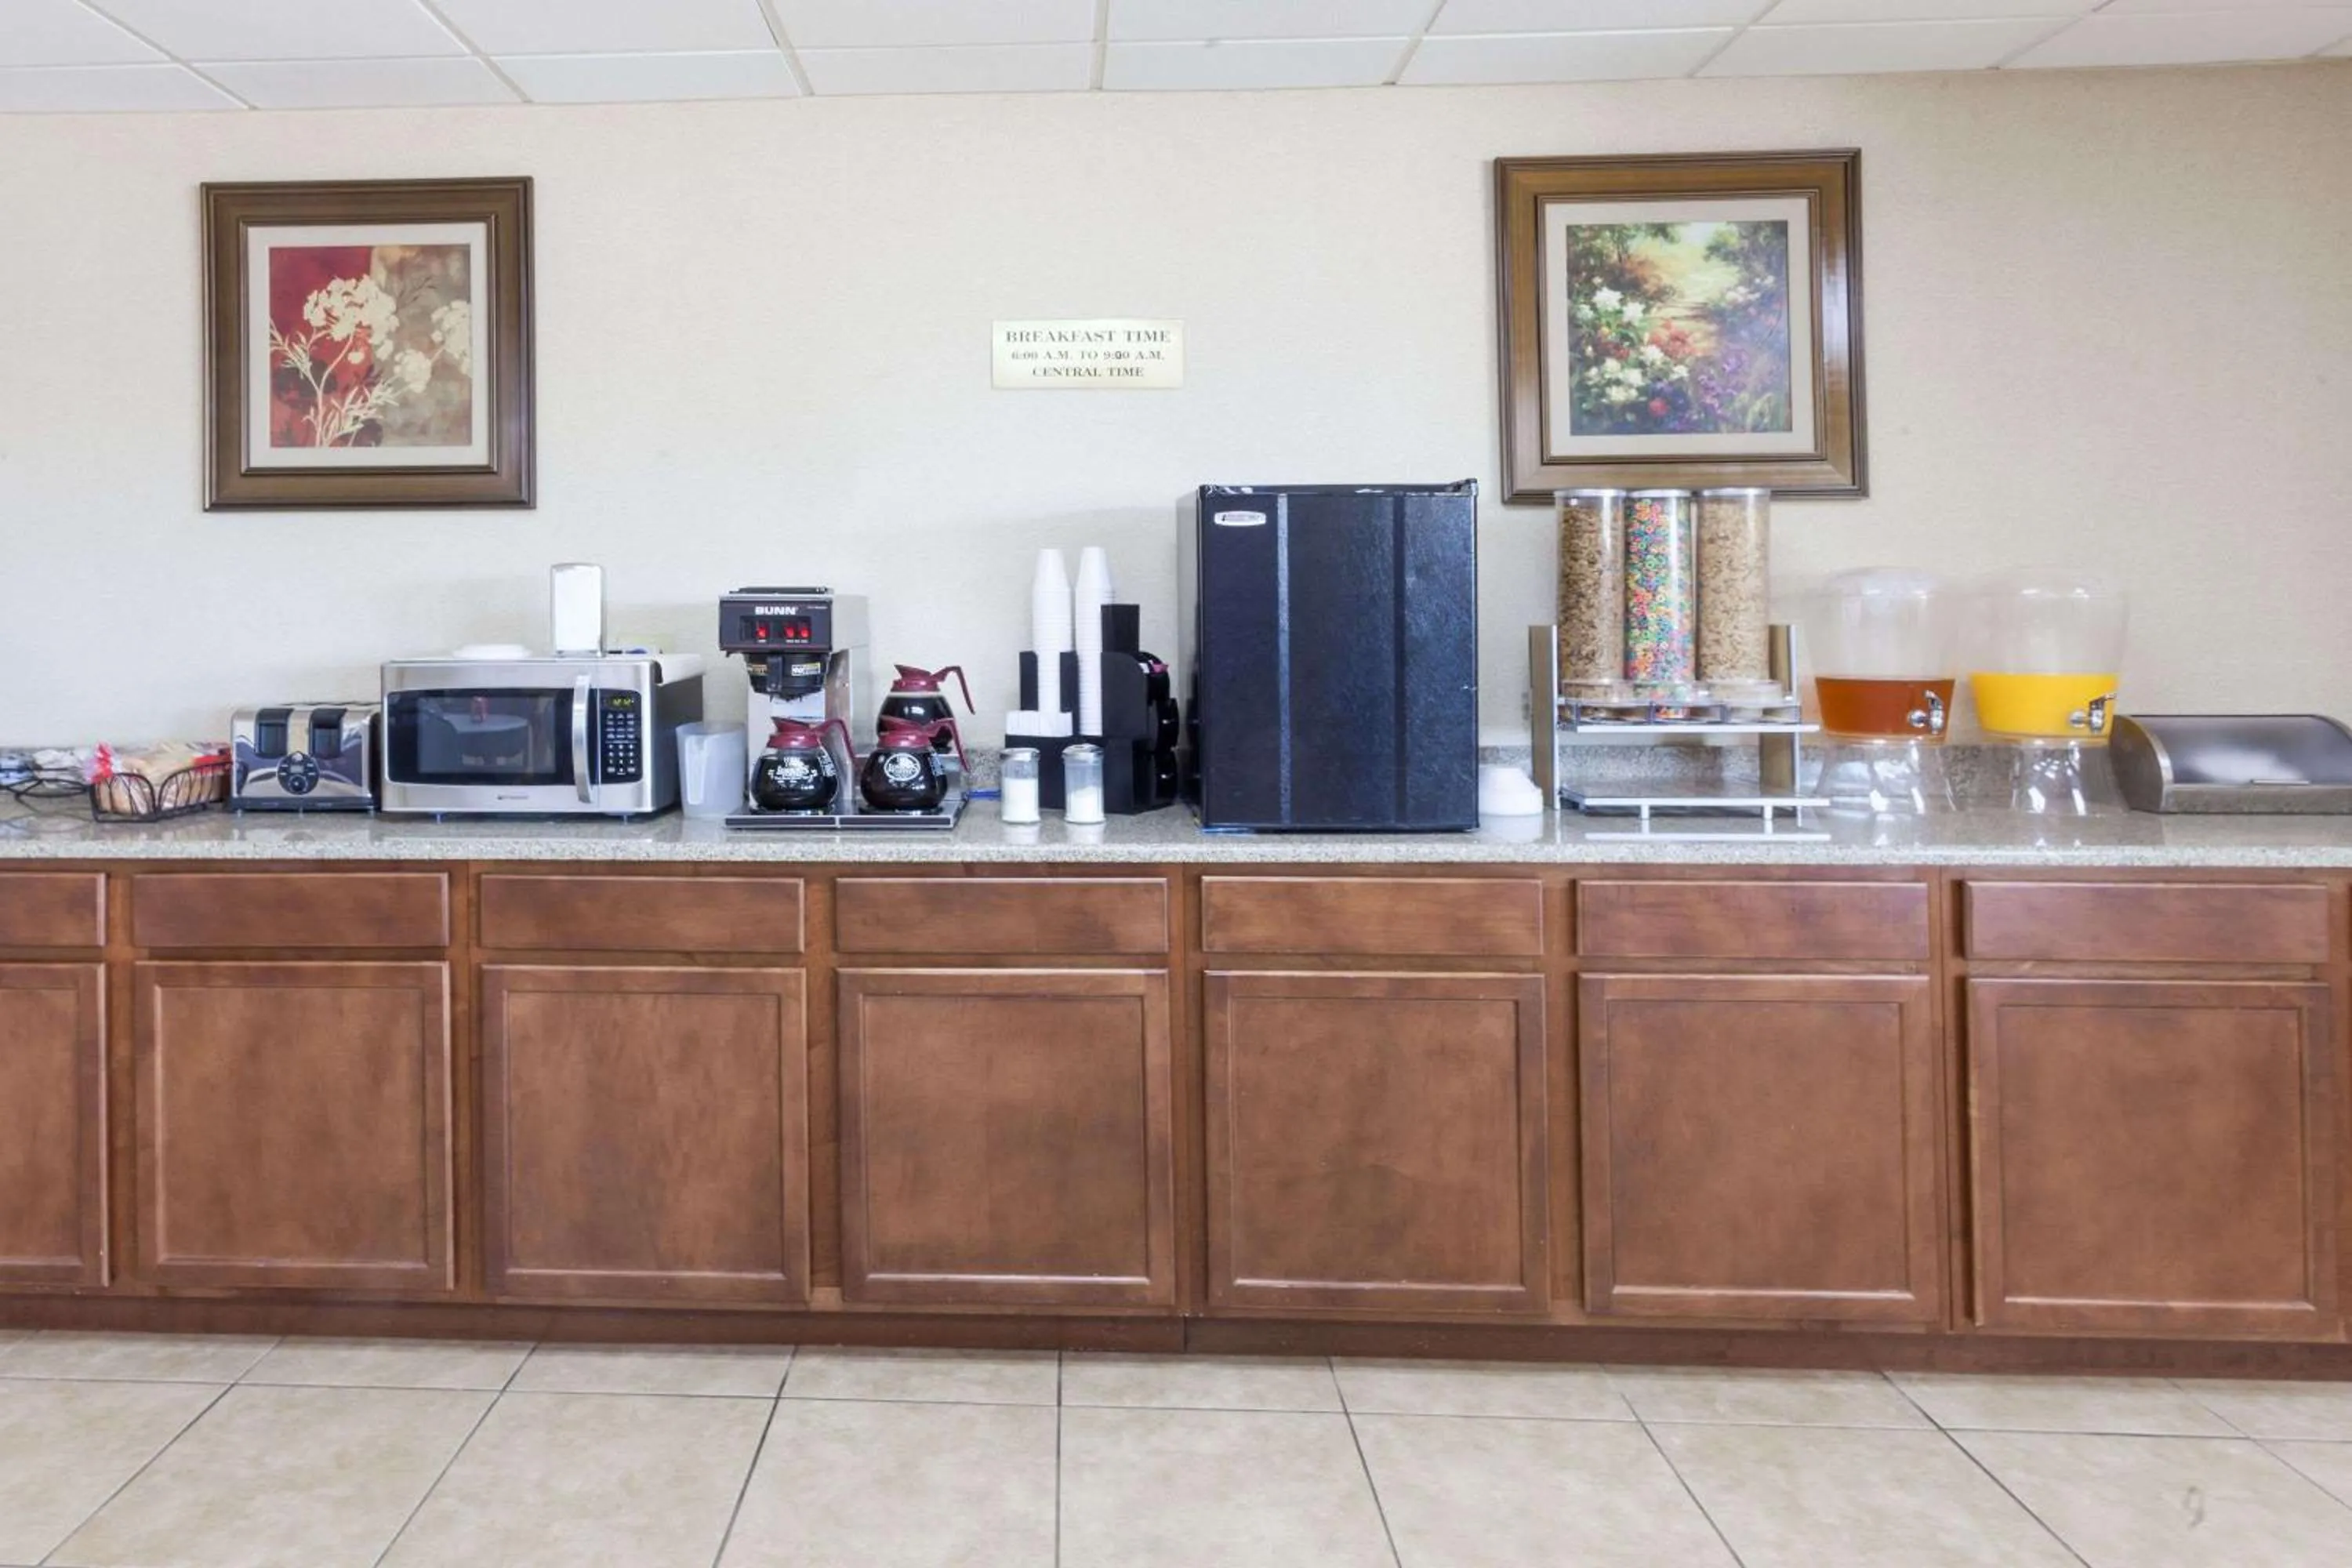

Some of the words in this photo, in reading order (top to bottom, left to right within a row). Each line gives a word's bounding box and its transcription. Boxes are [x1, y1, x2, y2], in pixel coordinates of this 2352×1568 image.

[1006, 329, 1116, 343] BREAKFAST
[1123, 329, 1171, 343] TIME
[1043, 350, 1073, 360] A.M.
[1080, 350, 1098, 360] TO
[1103, 350, 1130, 361] 9:00
[1134, 350, 1164, 361] A.M.
[1032, 366, 1102, 377] CENTRAL
[1108, 366, 1144, 377] TIME
[754, 605, 797, 615] BUNN
